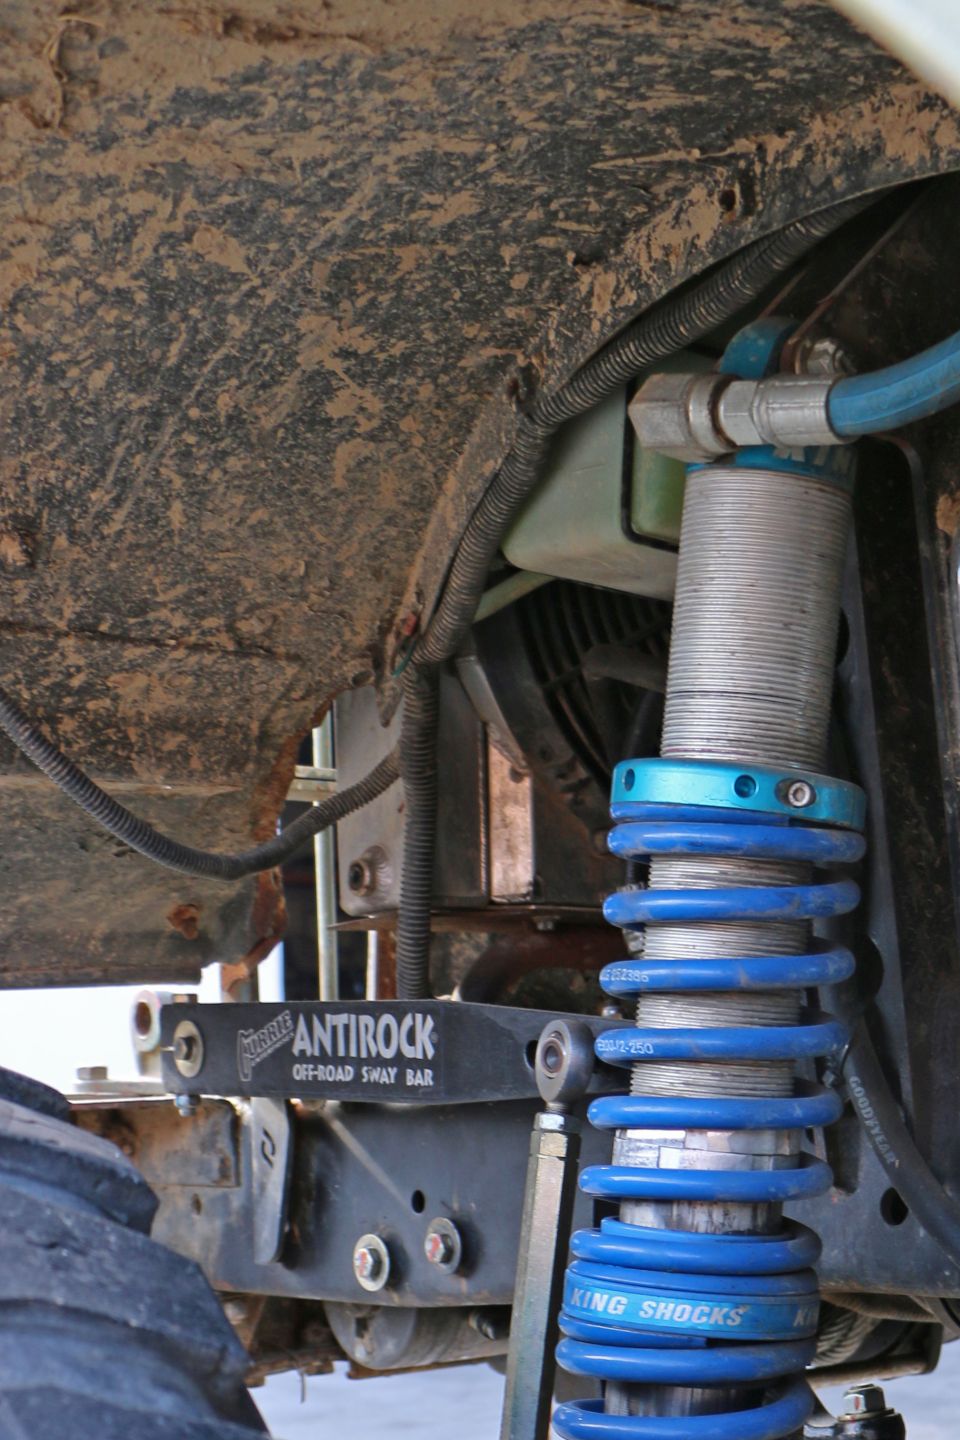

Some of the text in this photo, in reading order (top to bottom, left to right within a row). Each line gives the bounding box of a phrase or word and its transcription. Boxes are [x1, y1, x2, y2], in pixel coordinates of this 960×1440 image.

[294, 1013, 435, 1060] ANTIROCK
[293, 1064, 434, 1086] OFF-ROAD SWAY BAR
[571, 1287, 743, 1326] KING SHOCKS
